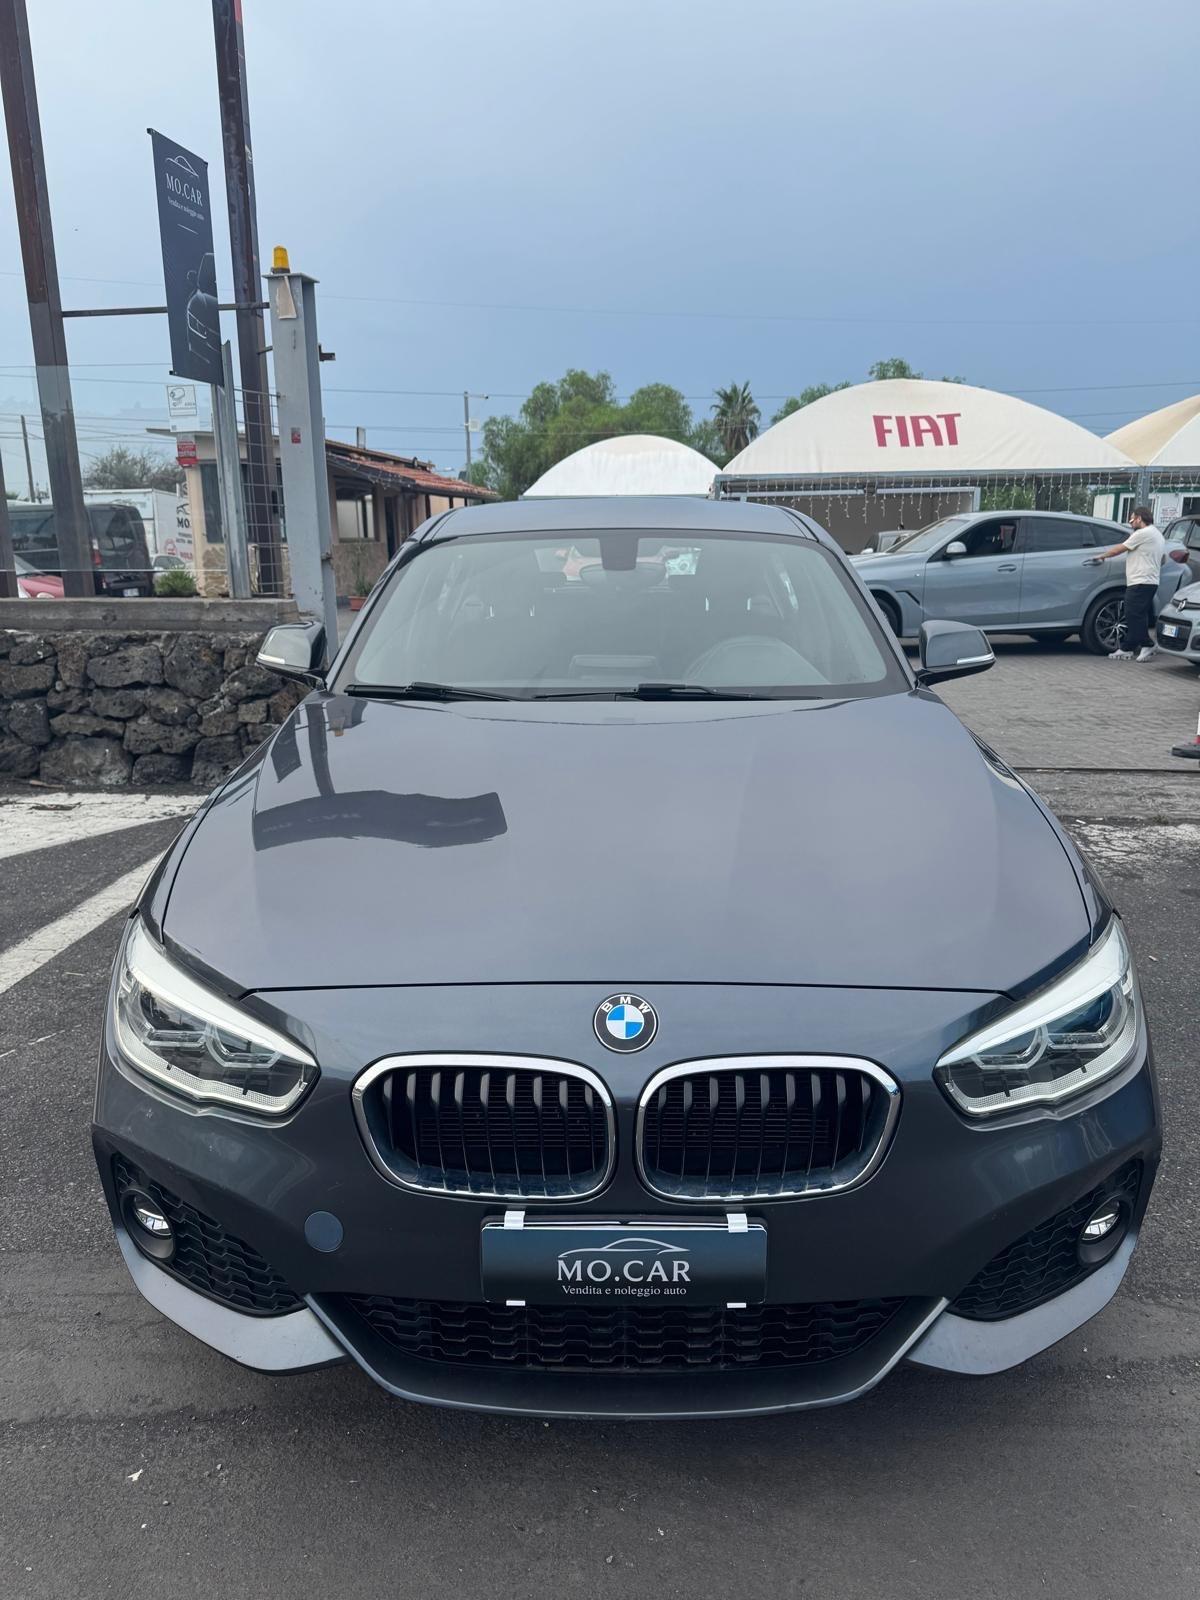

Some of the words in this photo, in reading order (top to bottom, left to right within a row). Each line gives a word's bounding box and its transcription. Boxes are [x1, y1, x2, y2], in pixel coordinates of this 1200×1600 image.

[166, 172, 203, 207] MO.CAR
[872, 412, 961, 447] FIAT
[601, 996, 651, 1014] BMW
[557, 1259, 691, 1282] MO.CAR
[562, 1285, 602, 1295] Vendita
[605, 1287, 611, 1295] e
[614, 1285, 661, 1298] noleggio
[663, 1286, 687, 1295] auto
